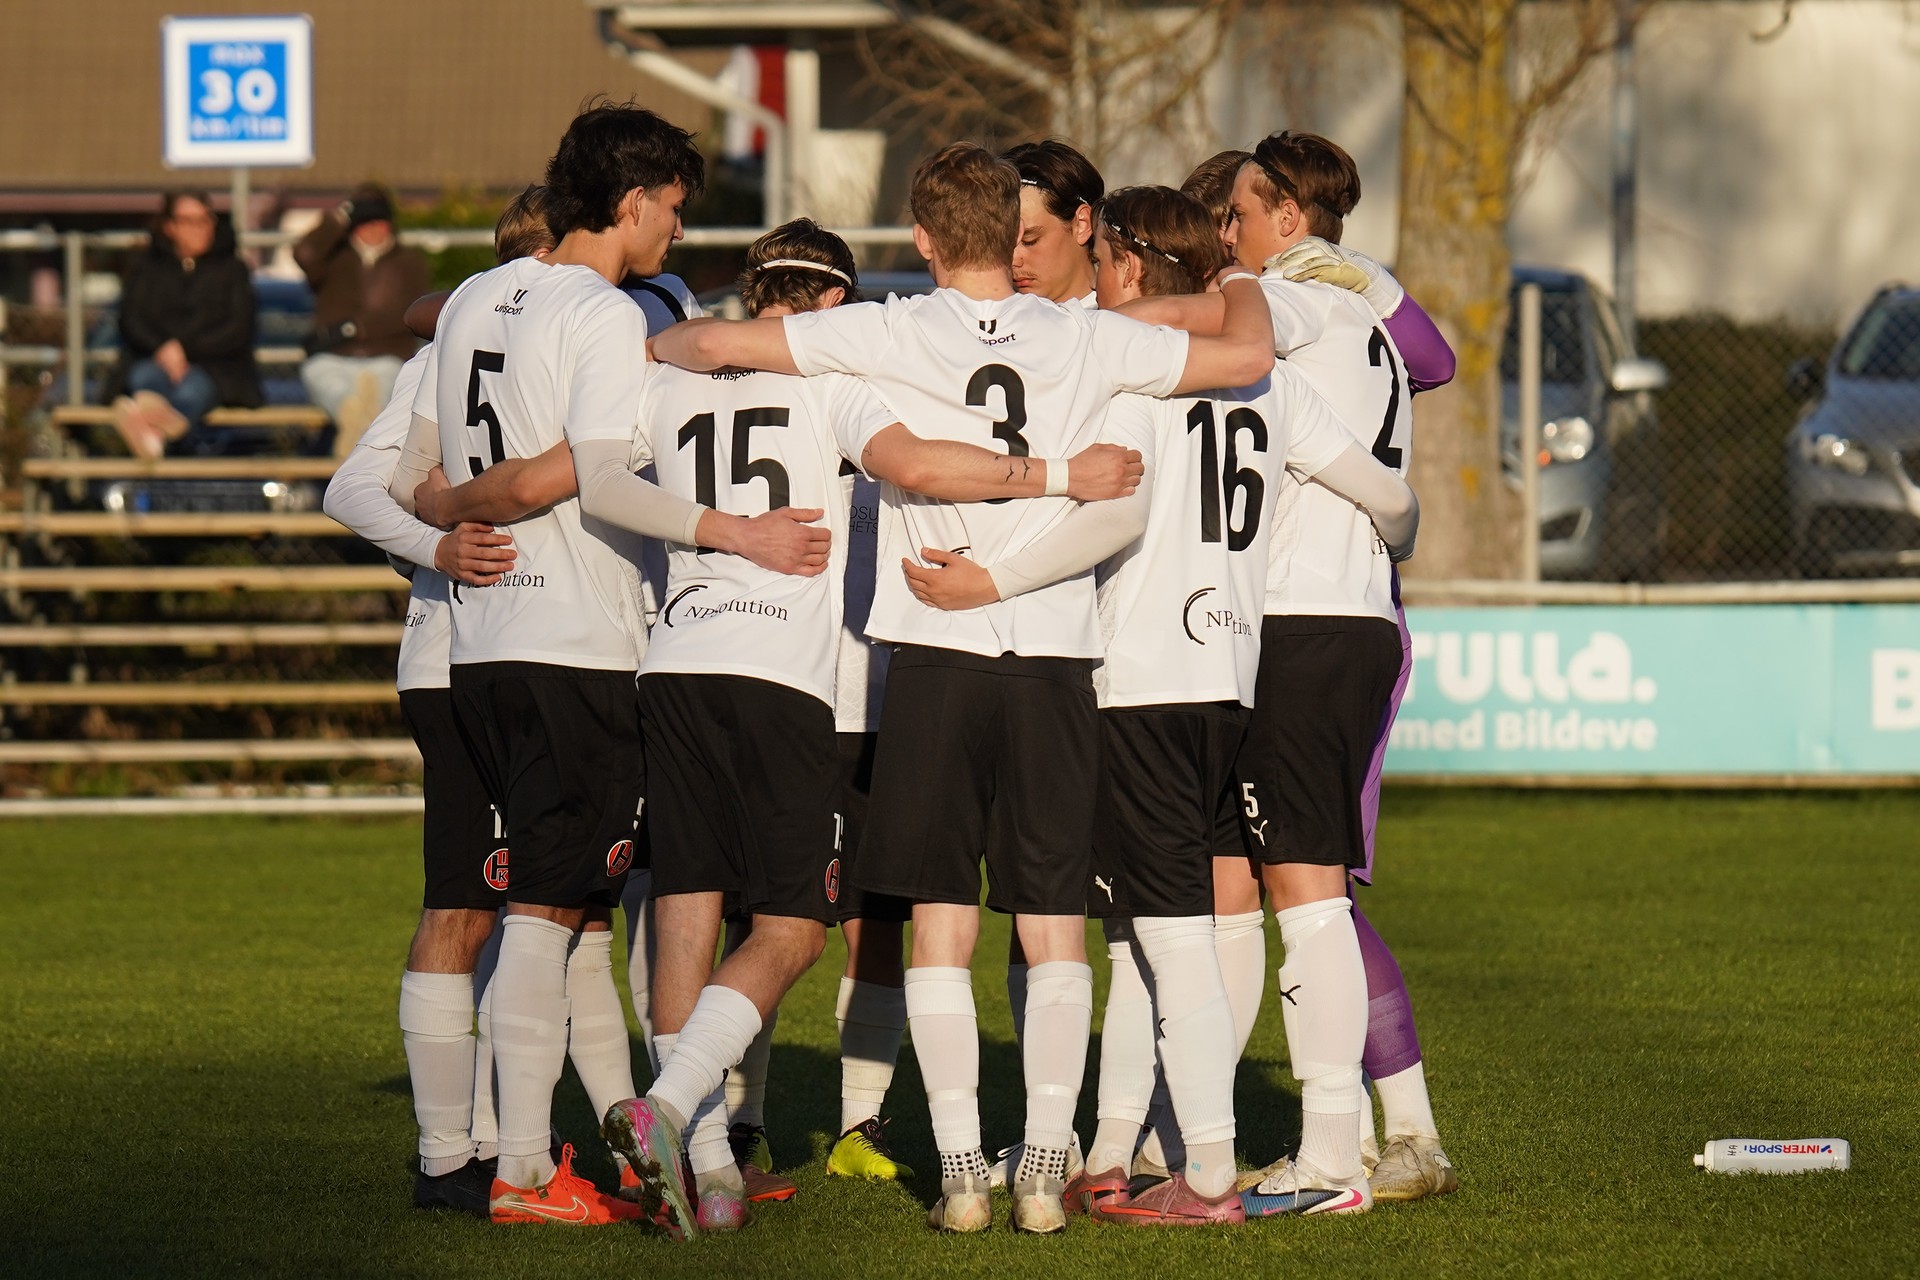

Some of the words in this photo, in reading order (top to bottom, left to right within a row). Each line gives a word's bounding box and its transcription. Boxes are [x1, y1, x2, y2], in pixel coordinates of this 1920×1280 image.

[199, 68, 277, 116] 30
[466, 349, 507, 478] 5
[965, 363, 1030, 504] 3
[1368, 325, 1402, 468] 2
[678, 407, 790, 555] 15
[1187, 400, 1268, 552] 16
[1496, 708, 1658, 749] Bildeve
[1242, 782, 1259, 818] 5
[1744, 1144, 1820, 1154] INTERSPOR
